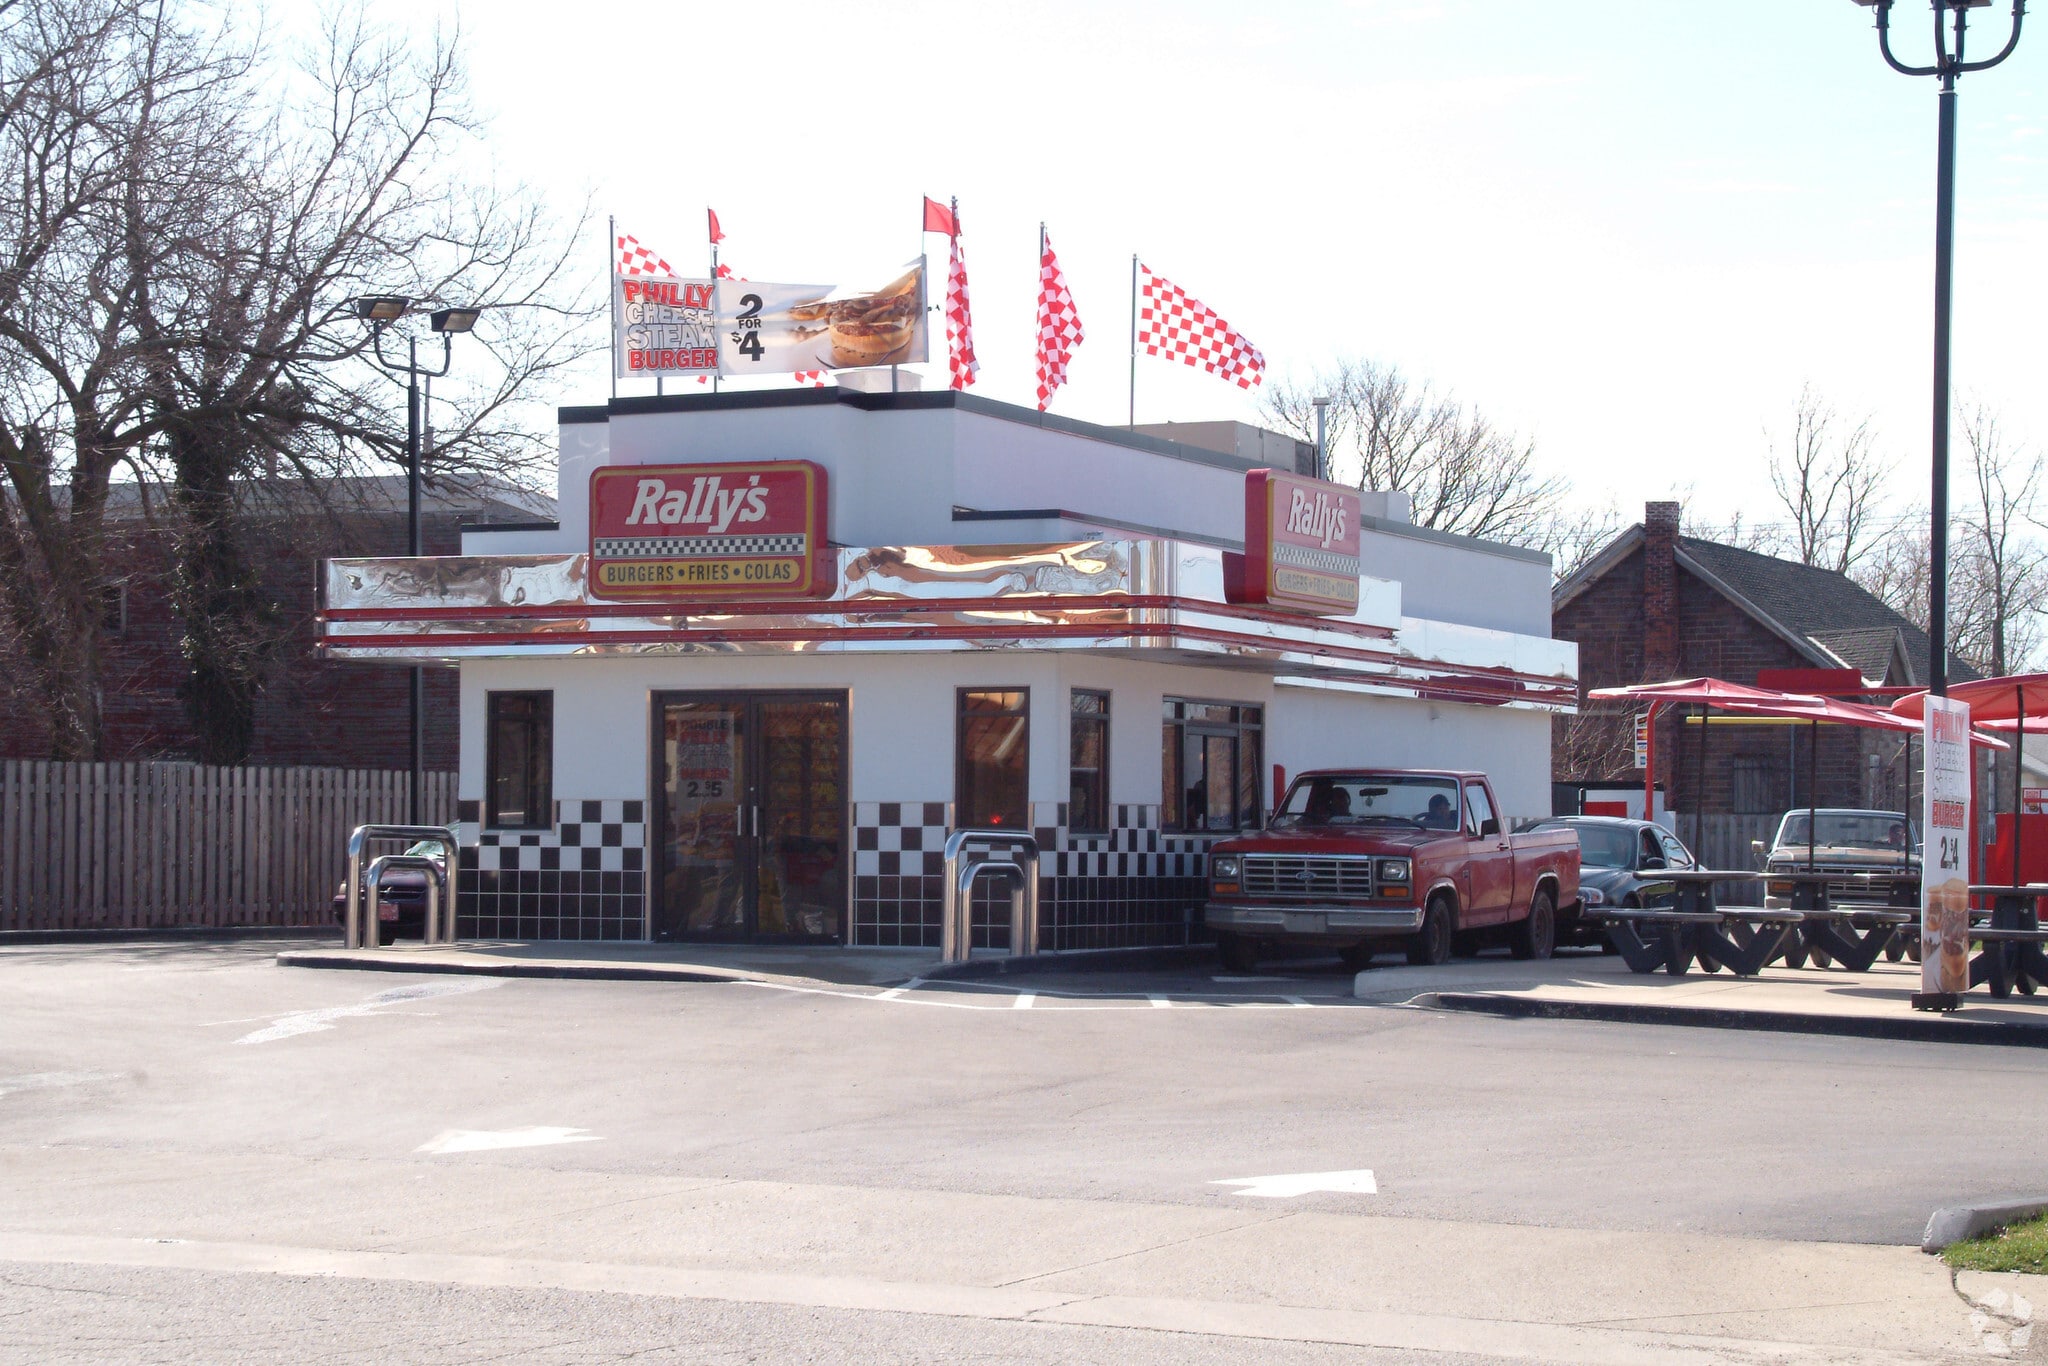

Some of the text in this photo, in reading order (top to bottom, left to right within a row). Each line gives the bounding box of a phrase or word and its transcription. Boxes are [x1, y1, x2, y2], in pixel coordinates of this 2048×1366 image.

[622, 280, 715, 310] PHILLY
[736, 294, 763, 319] 2
[626, 302, 714, 326] CHEESE
[738, 319, 762, 329] FOR
[627, 324, 718, 350] STEAK
[731, 331, 765, 361] $4
[628, 349, 719, 370] BURGER
[625, 475, 769, 533] Rally's
[1286, 487, 1347, 548] Rally's
[607, 563, 791, 582] BURGERS FRIES COLAS
[1313, 577, 1331, 595] FRIES
[1932, 709, 1965, 744] PHILLY
[687, 781, 722, 798] 2 $5
[1932, 801, 1965, 830] BURGER
[1940, 836, 1948, 869] 2
